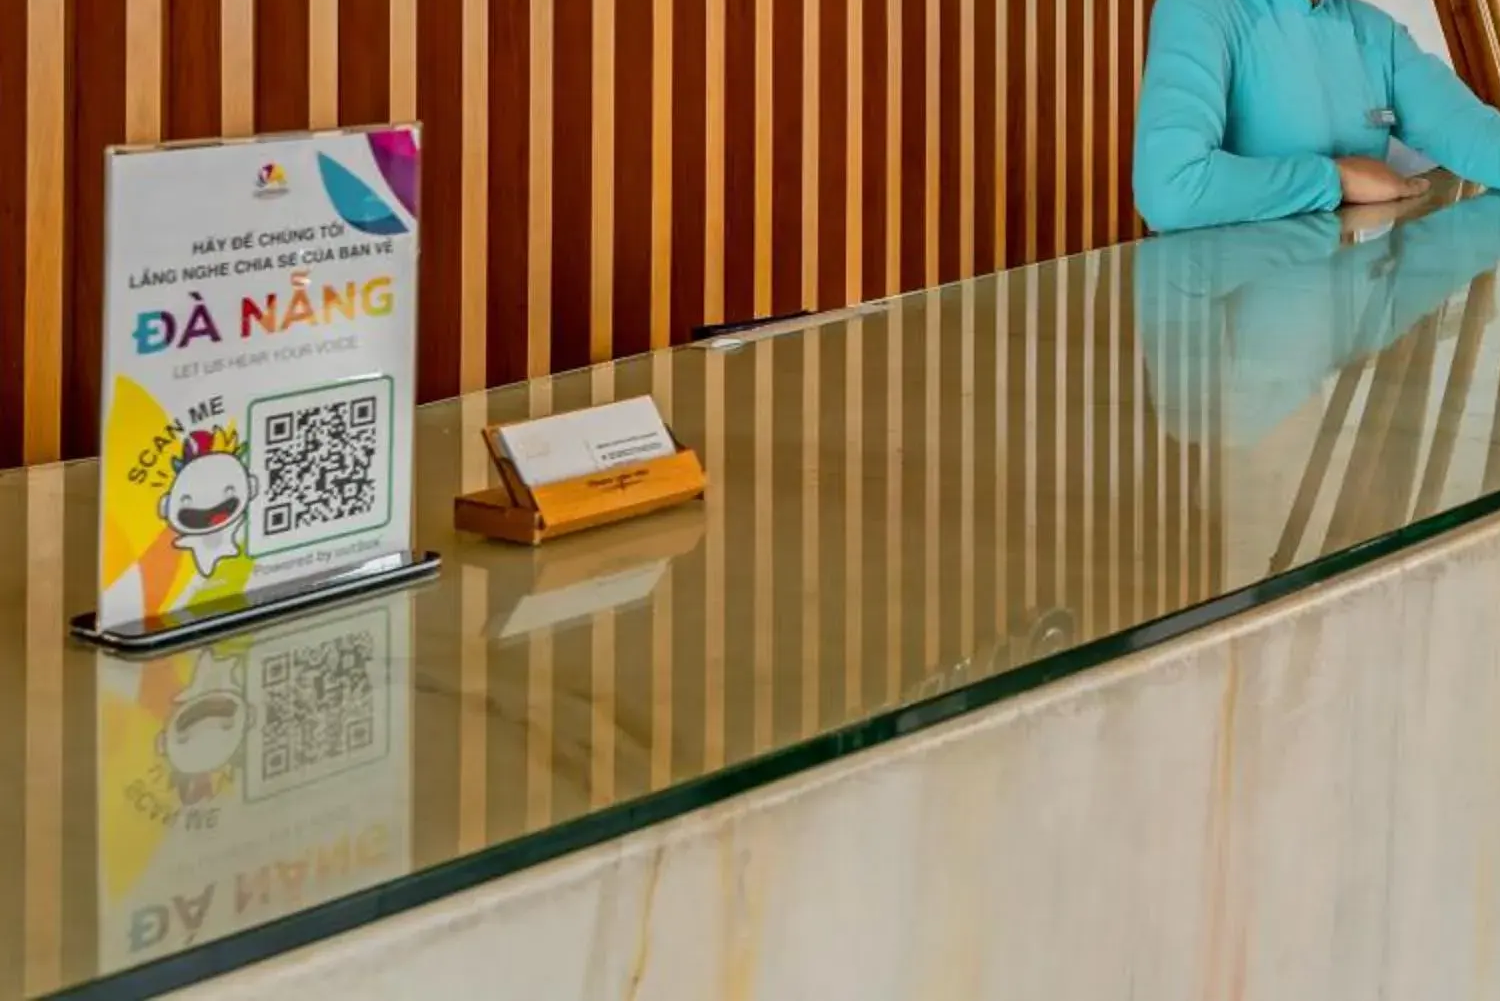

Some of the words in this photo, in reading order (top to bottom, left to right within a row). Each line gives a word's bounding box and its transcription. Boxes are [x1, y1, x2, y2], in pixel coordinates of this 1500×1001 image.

[182, 261, 229, 282] NGHE
[131, 291, 222, 355] ĐÀ
[127, 417, 185, 485] SCAN
[188, 395, 225, 424] ME
